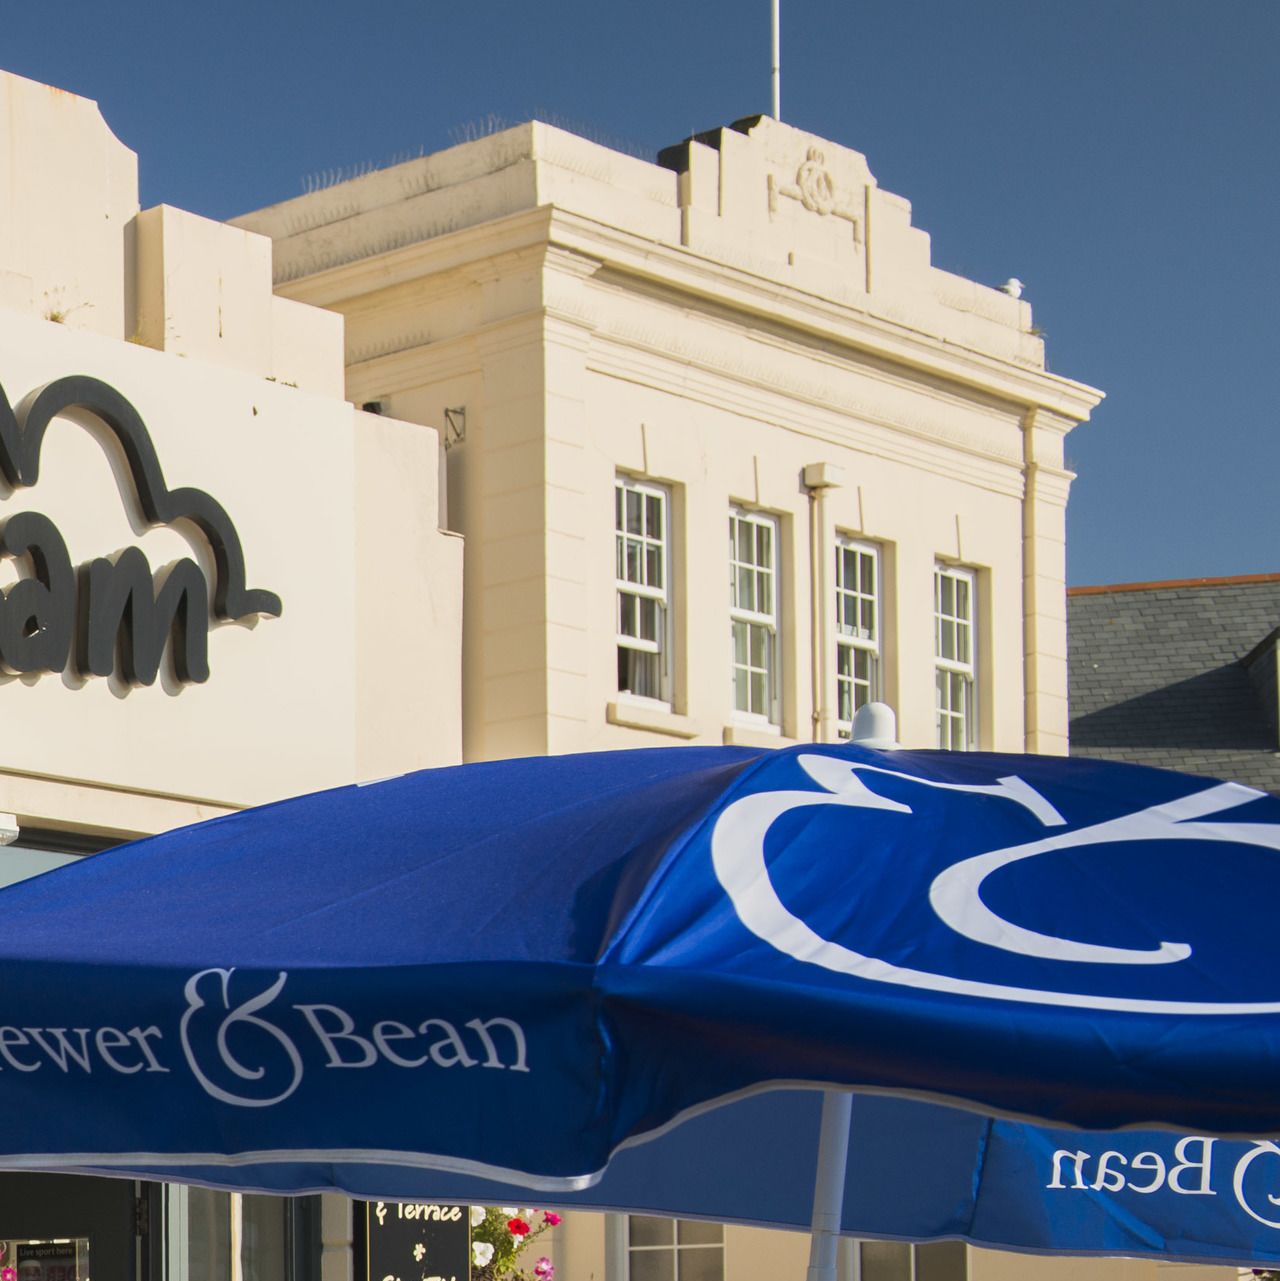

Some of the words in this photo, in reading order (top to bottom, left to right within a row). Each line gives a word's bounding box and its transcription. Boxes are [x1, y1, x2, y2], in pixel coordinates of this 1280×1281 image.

[180, 967, 303, 1108] &
[293, 1003, 530, 1073] Bean
[398, 1202, 462, 1222] Terrace
